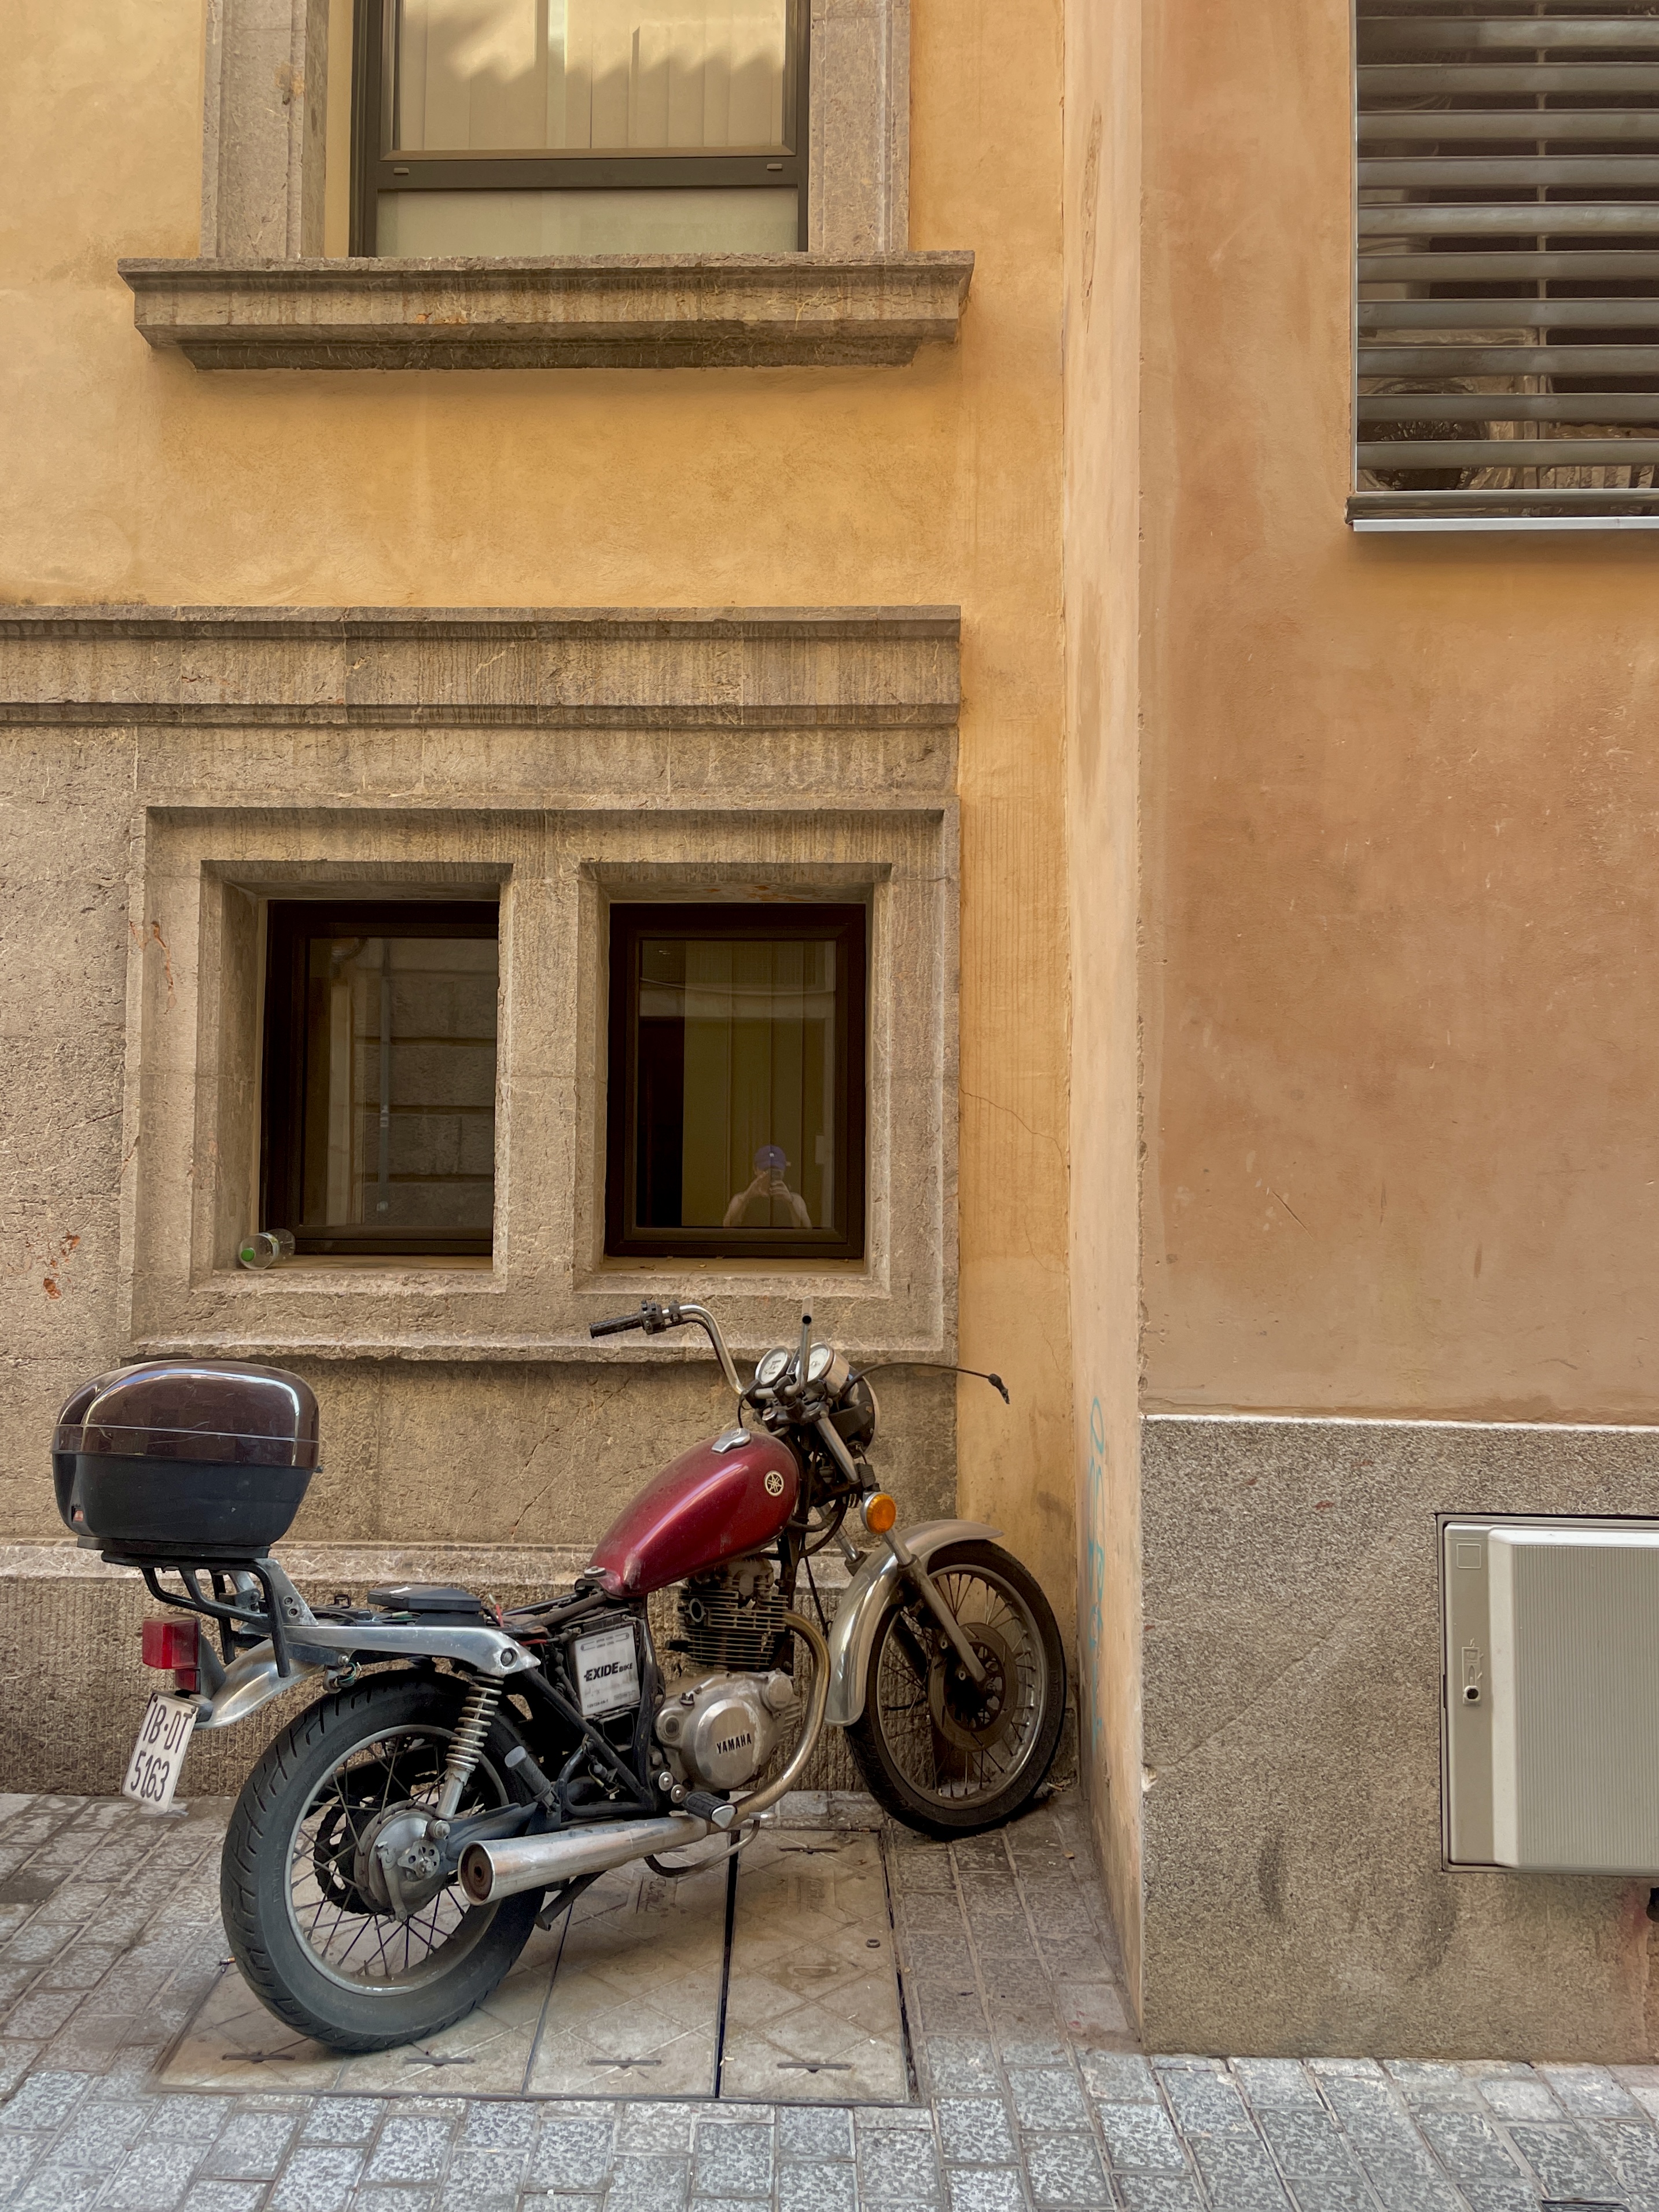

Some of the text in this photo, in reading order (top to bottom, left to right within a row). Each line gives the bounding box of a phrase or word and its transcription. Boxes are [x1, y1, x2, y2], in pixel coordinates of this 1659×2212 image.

[584, 1661, 633, 1682] EXIDE BIKE
[716, 1733, 752, 1754] YAMAHA
[130, 1750, 170, 1802] 5163
